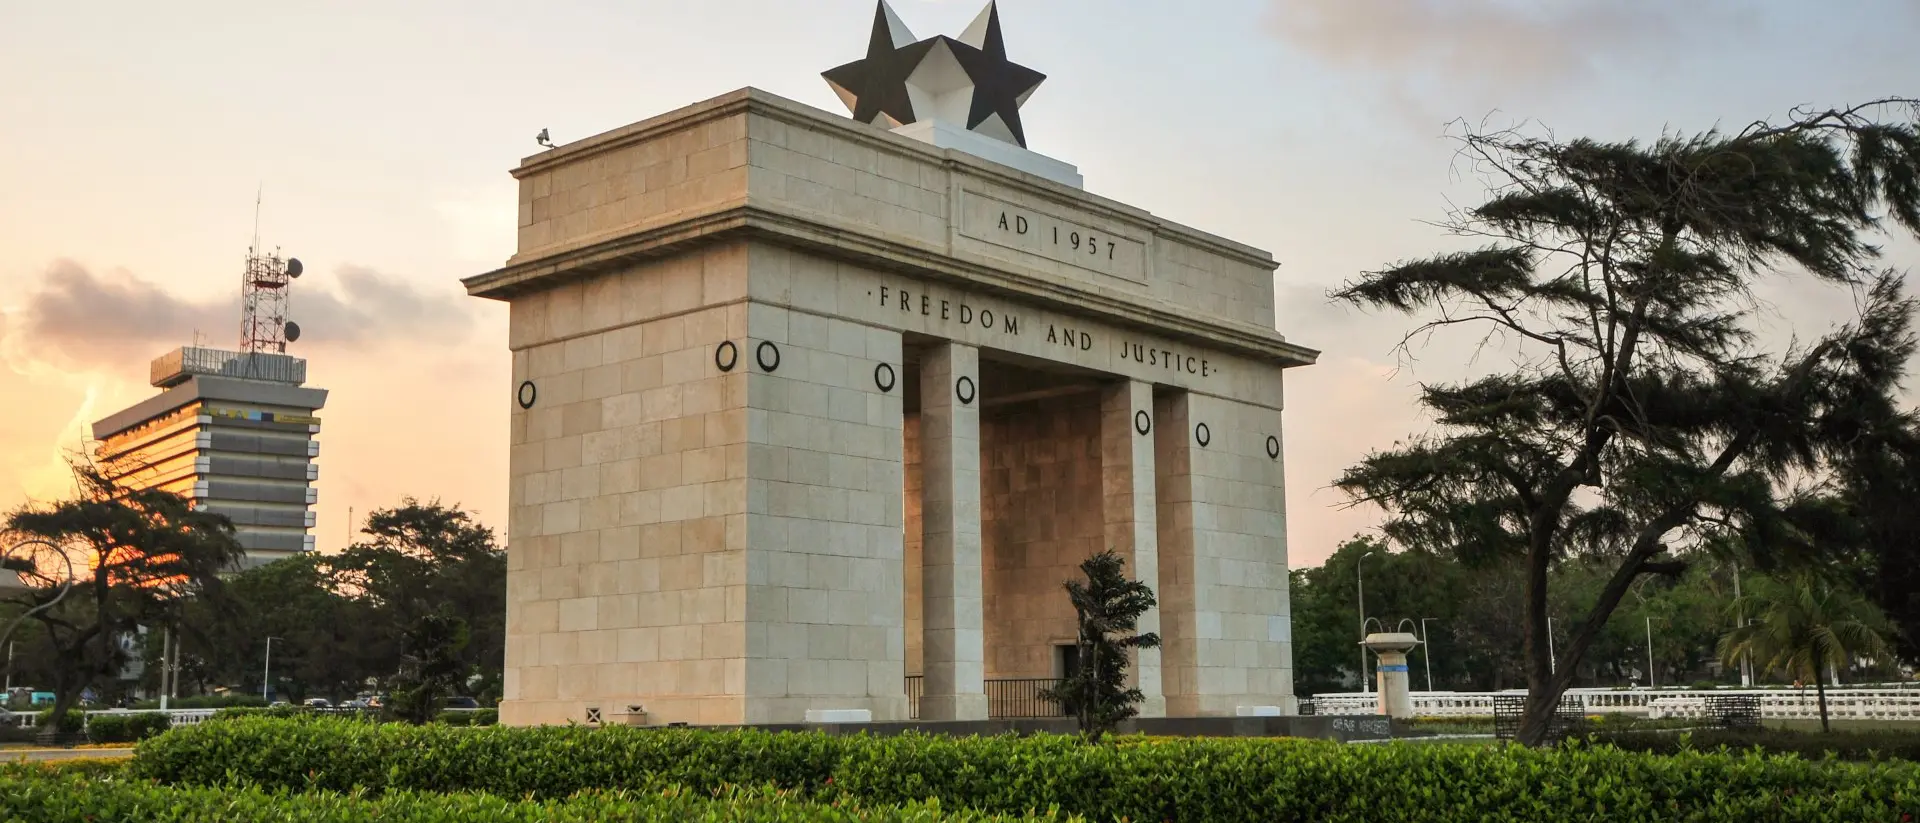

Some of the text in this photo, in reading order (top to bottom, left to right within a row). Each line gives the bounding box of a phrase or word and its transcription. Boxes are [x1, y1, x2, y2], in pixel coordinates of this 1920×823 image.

[998, 212, 1116, 260] AD 1957
[880, 286, 1209, 377] FREEDOM AND JUSTICE
